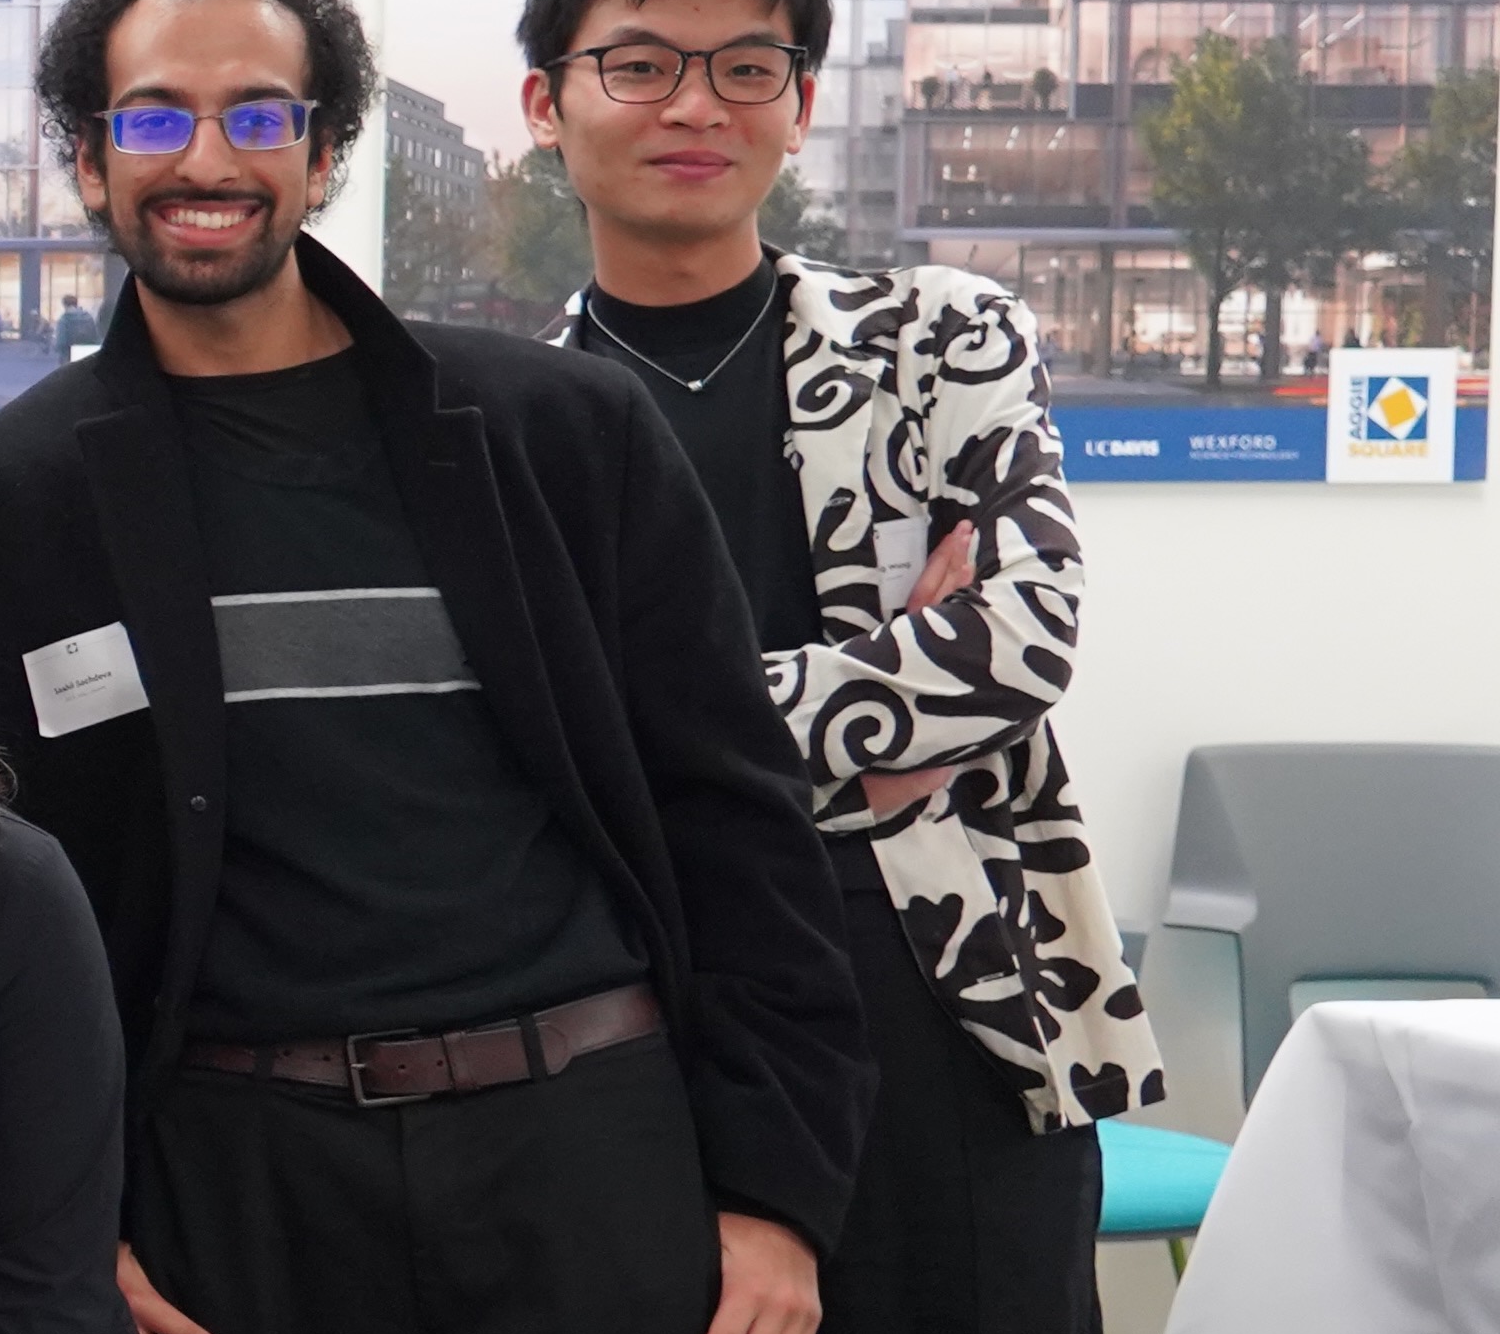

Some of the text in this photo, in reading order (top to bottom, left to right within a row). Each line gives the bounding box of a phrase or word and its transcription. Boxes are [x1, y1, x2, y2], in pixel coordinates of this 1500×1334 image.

[1349, 376, 1363, 440] AGGIE
[1189, 435, 1278, 451] WEXFORD
[1348, 442, 1428, 457] SQUARE
